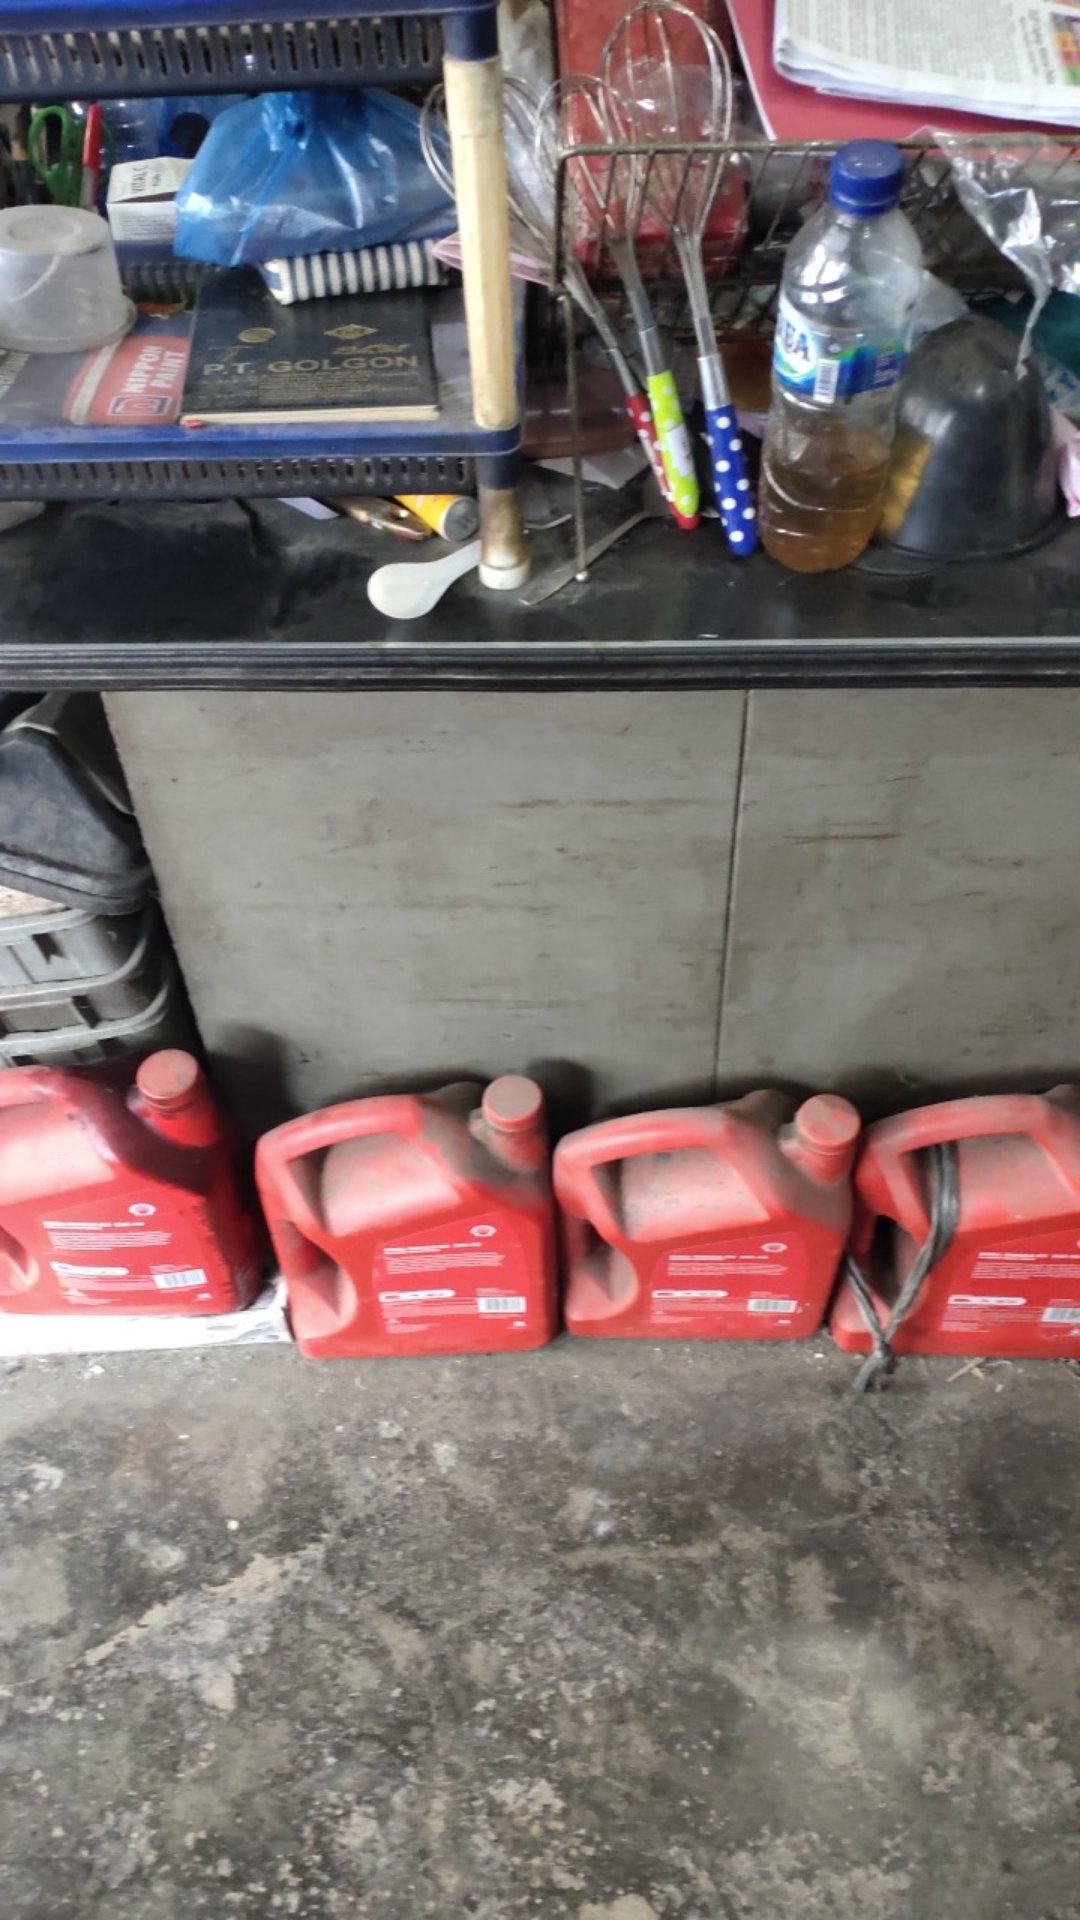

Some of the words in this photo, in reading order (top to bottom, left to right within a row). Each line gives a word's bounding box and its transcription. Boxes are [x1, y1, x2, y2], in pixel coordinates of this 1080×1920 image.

[121, 345, 163, 394] NIPPON
[149, 350, 185, 389] PAINT
[203, 361, 256, 376] P.T.
[266, 355, 419, 374] GOLGON
